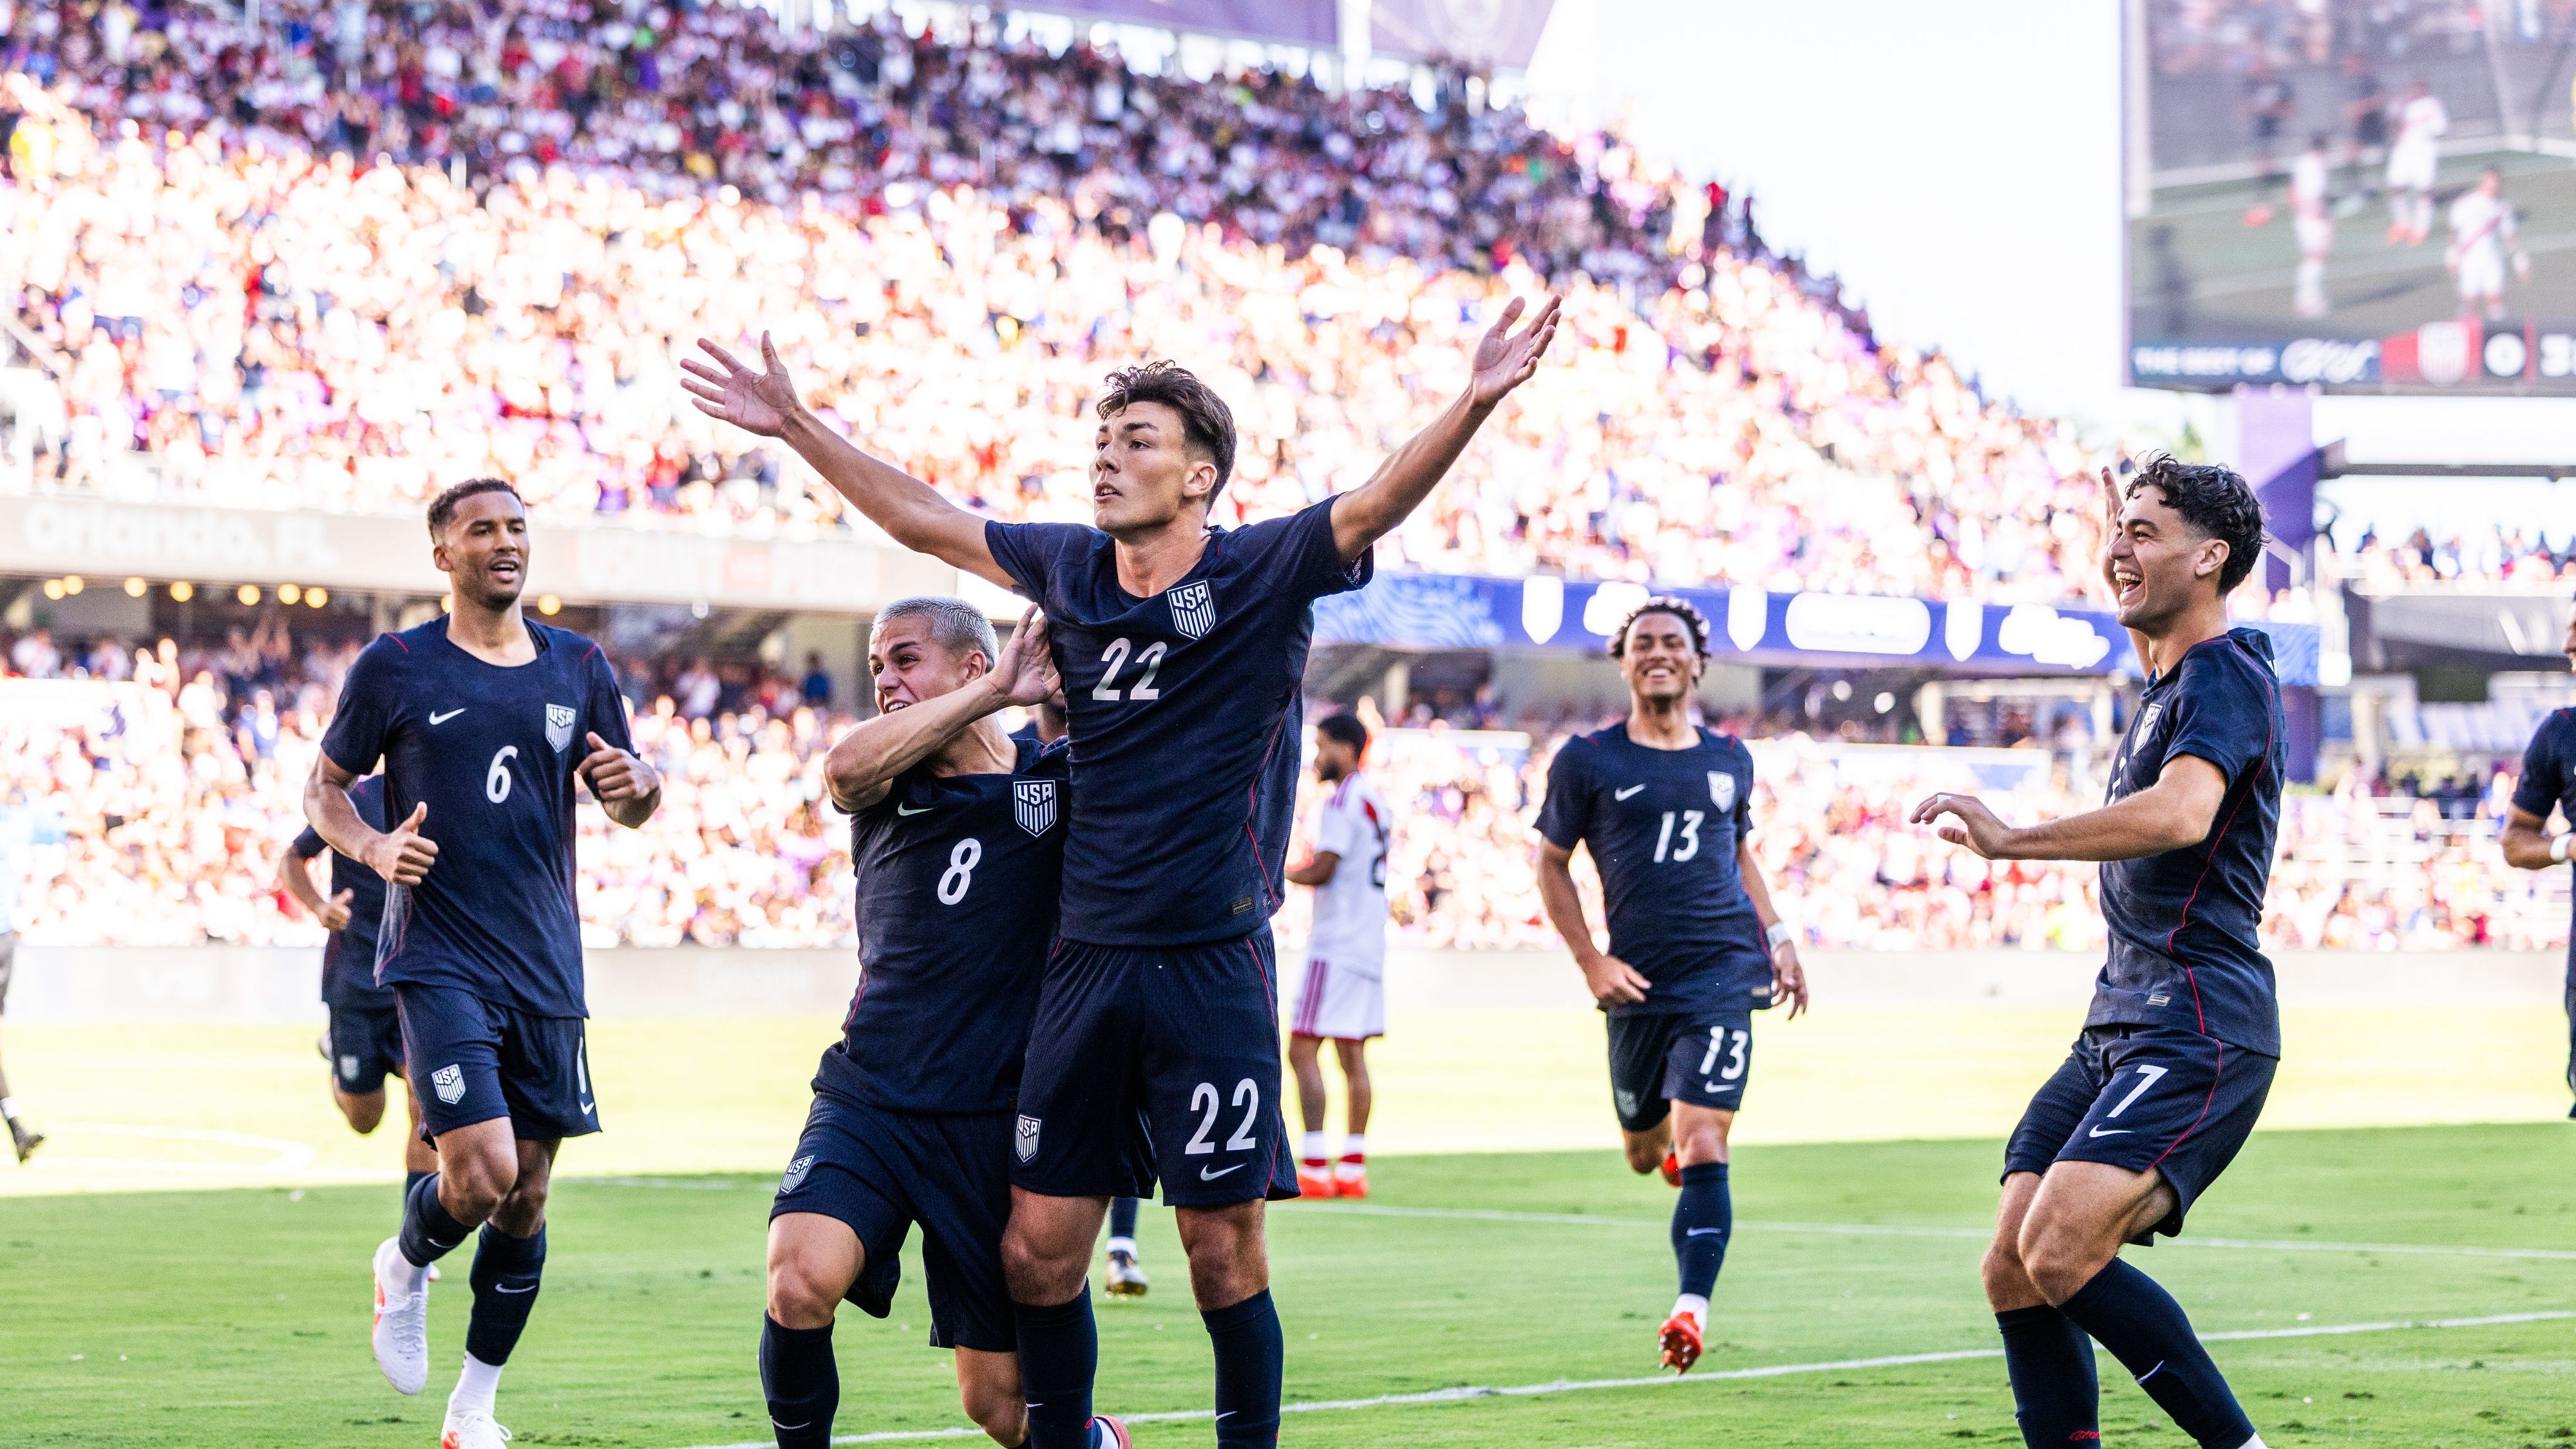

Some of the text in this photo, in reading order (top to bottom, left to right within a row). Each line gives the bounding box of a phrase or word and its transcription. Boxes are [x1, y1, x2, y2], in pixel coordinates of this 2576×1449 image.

[1171, 584, 1207, 609] USA
[1092, 638, 1168, 701] 22
[548, 707, 574, 727] USA
[486, 745, 518, 804] 6
[1017, 784, 1052, 805] USA
[1653, 810, 1705, 863] 13
[938, 838, 981, 905] 8
[434, 1067, 459, 1084] USA
[1699, 1026, 1748, 1080] 13
[1184, 1078, 1258, 1155] 22
[2107, 1065, 2168, 1118] 7
[1018, 1117, 1038, 1137] USA
[788, 1157, 811, 1173] USA
